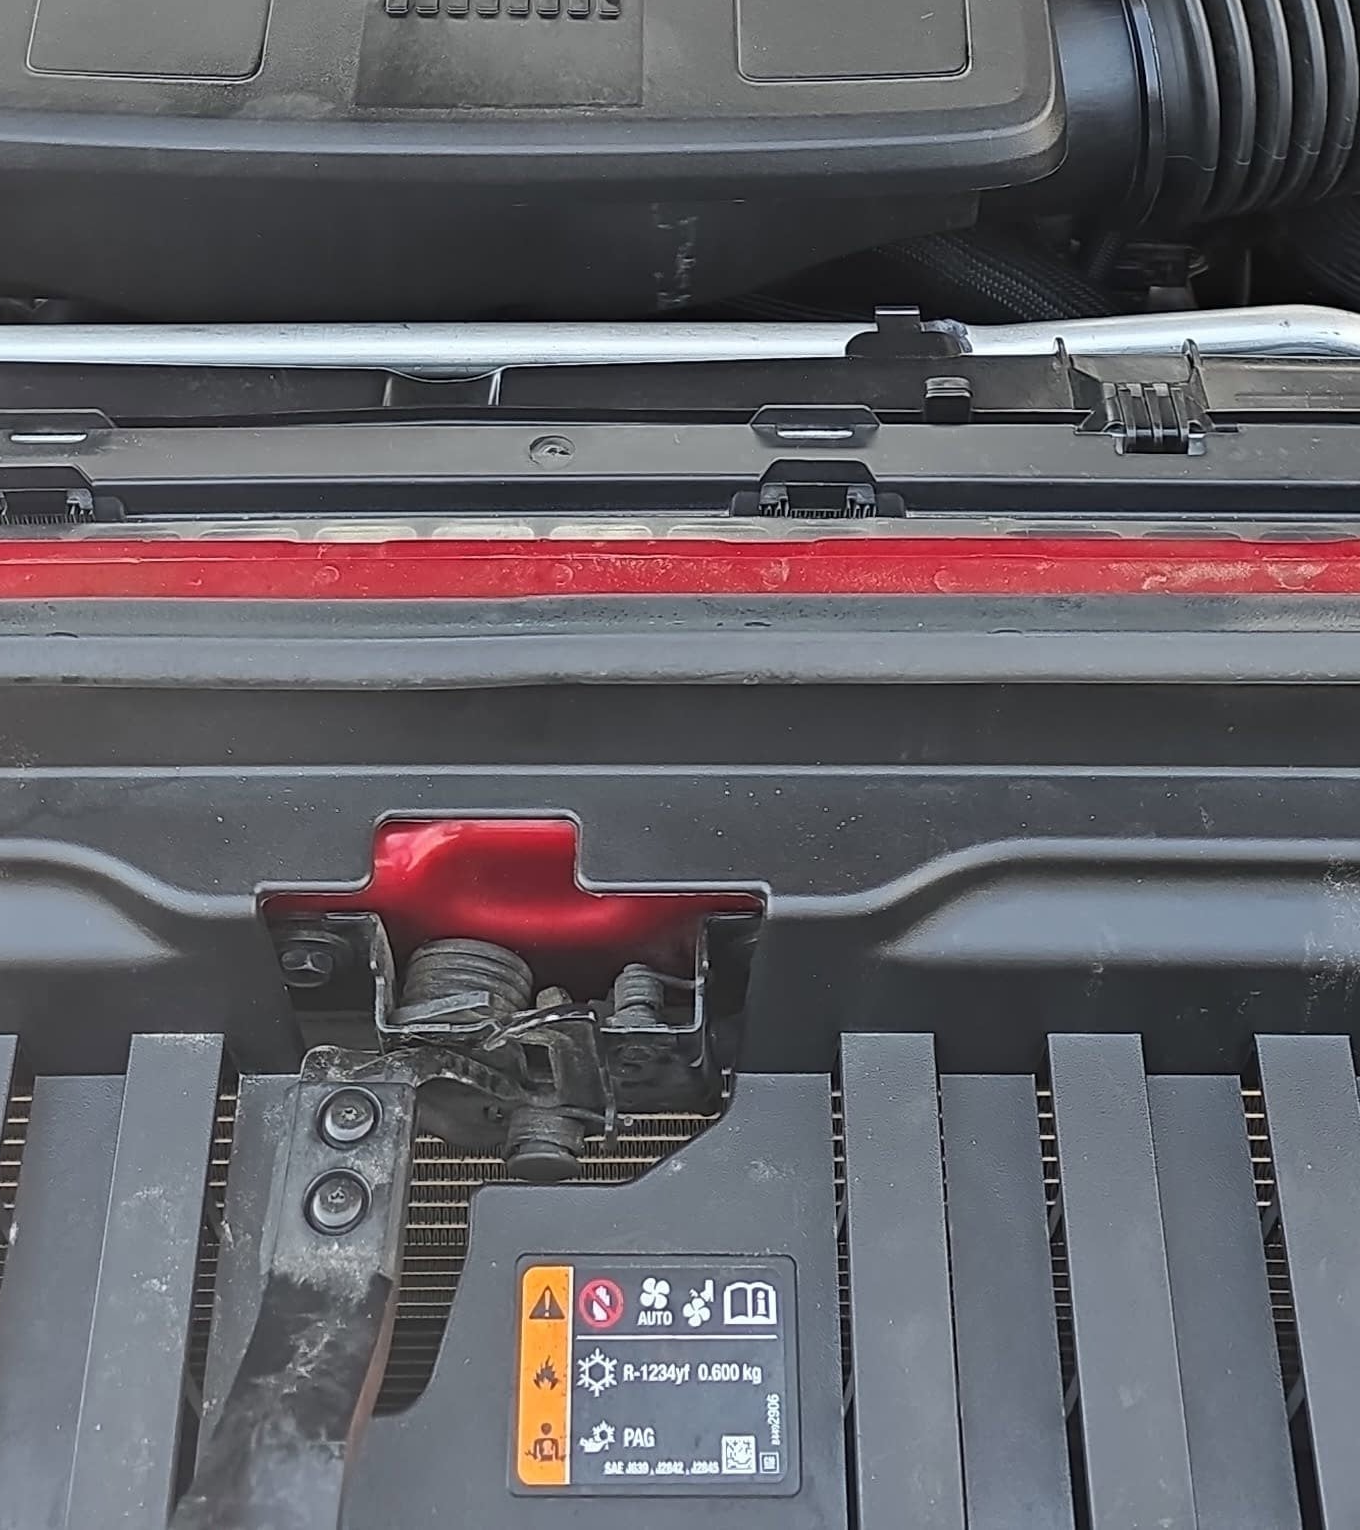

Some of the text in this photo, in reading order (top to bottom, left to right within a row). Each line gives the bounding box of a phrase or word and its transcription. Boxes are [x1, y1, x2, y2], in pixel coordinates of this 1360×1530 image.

[637, 1310, 673, 1326] AUTO
[623, 1362, 762, 1385] R-1234yf 0.600 kg
[623, 1427, 656, 1448] PAG
[603, 1460, 625, 1475] SAE
